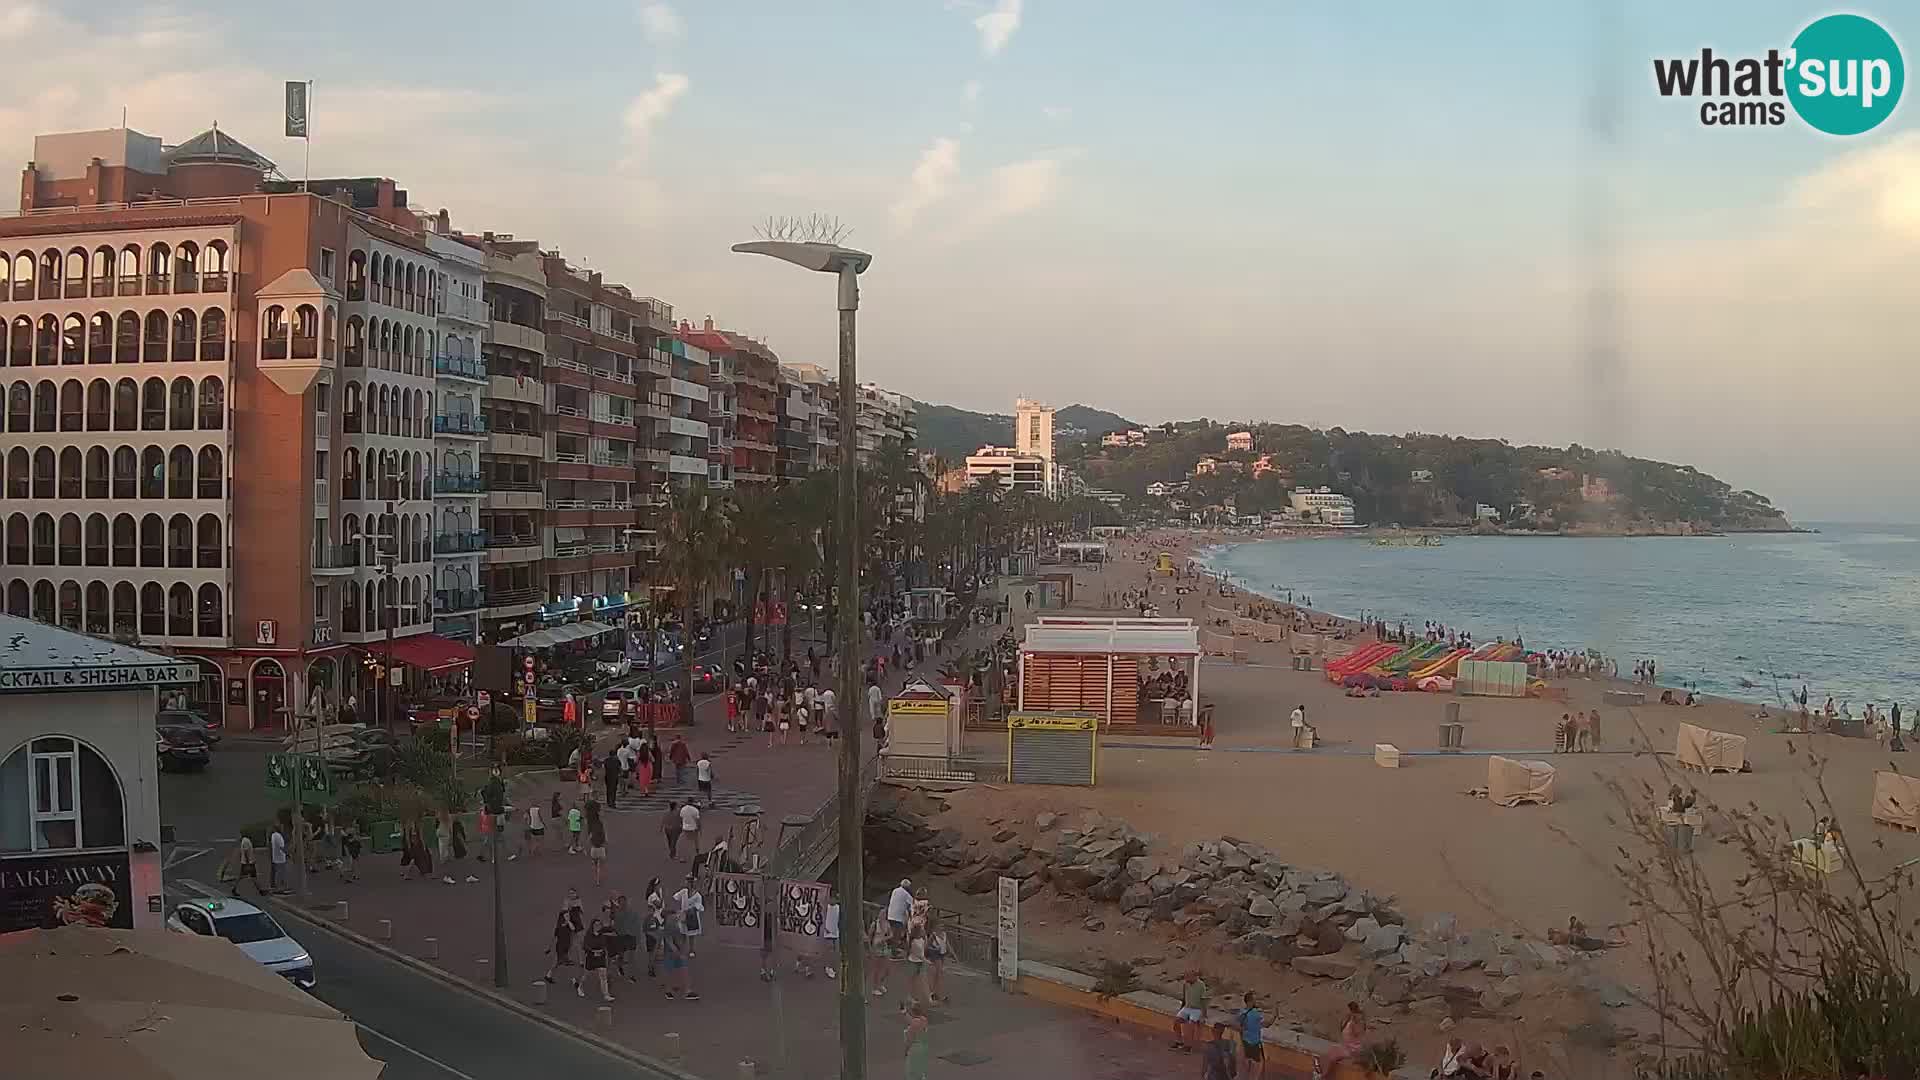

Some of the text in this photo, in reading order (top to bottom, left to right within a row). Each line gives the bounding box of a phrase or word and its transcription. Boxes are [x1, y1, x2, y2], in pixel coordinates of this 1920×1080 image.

[314, 627, 332, 643] KFC
[64, 671, 75, 684] &
[80, 668, 140, 684] SHISHA
[145, 667, 178, 681] BAR
